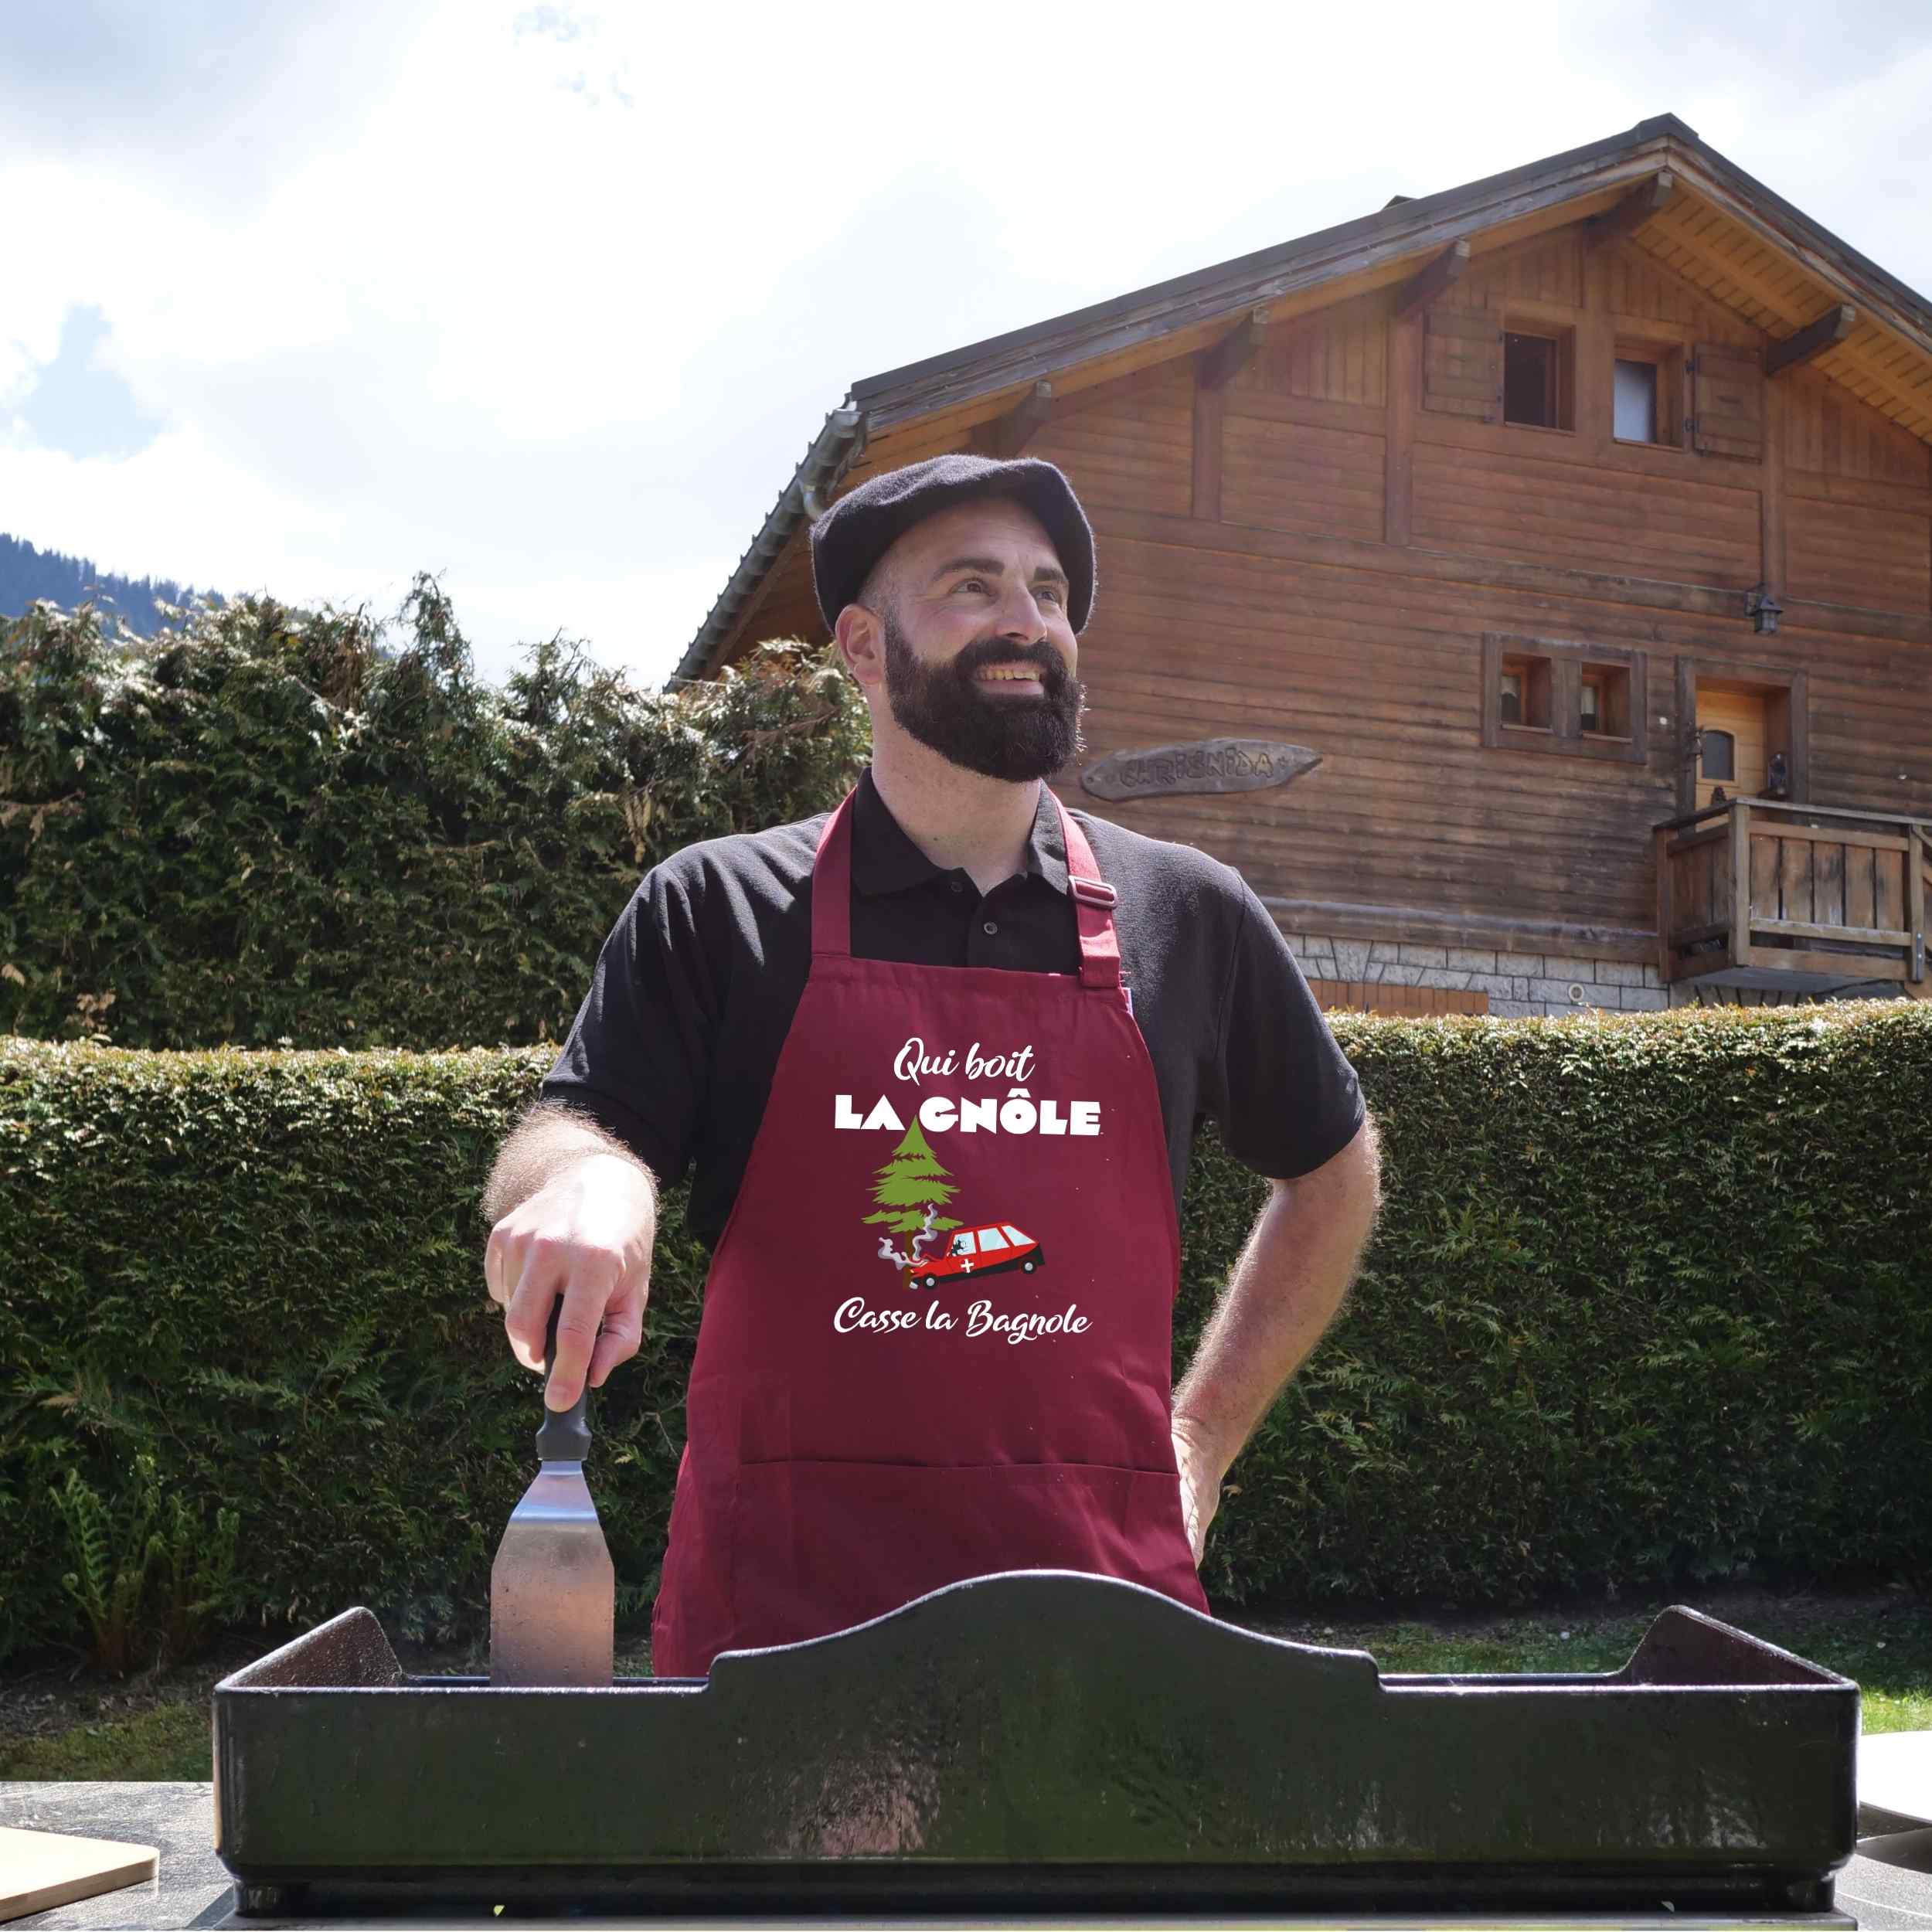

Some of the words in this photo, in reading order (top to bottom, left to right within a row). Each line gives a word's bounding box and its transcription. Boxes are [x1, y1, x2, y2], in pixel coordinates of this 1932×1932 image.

[893, 1037, 960, 1086] Qui
[964, 1042, 1036, 1082] boit
[835, 1094, 906, 1131] LA
[919, 1087, 1101, 1136] GNÔLE
[833, 1296, 923, 1333] Casse
[925, 1300, 959, 1331] la
[964, 1299, 1094, 1345] Bagnole
